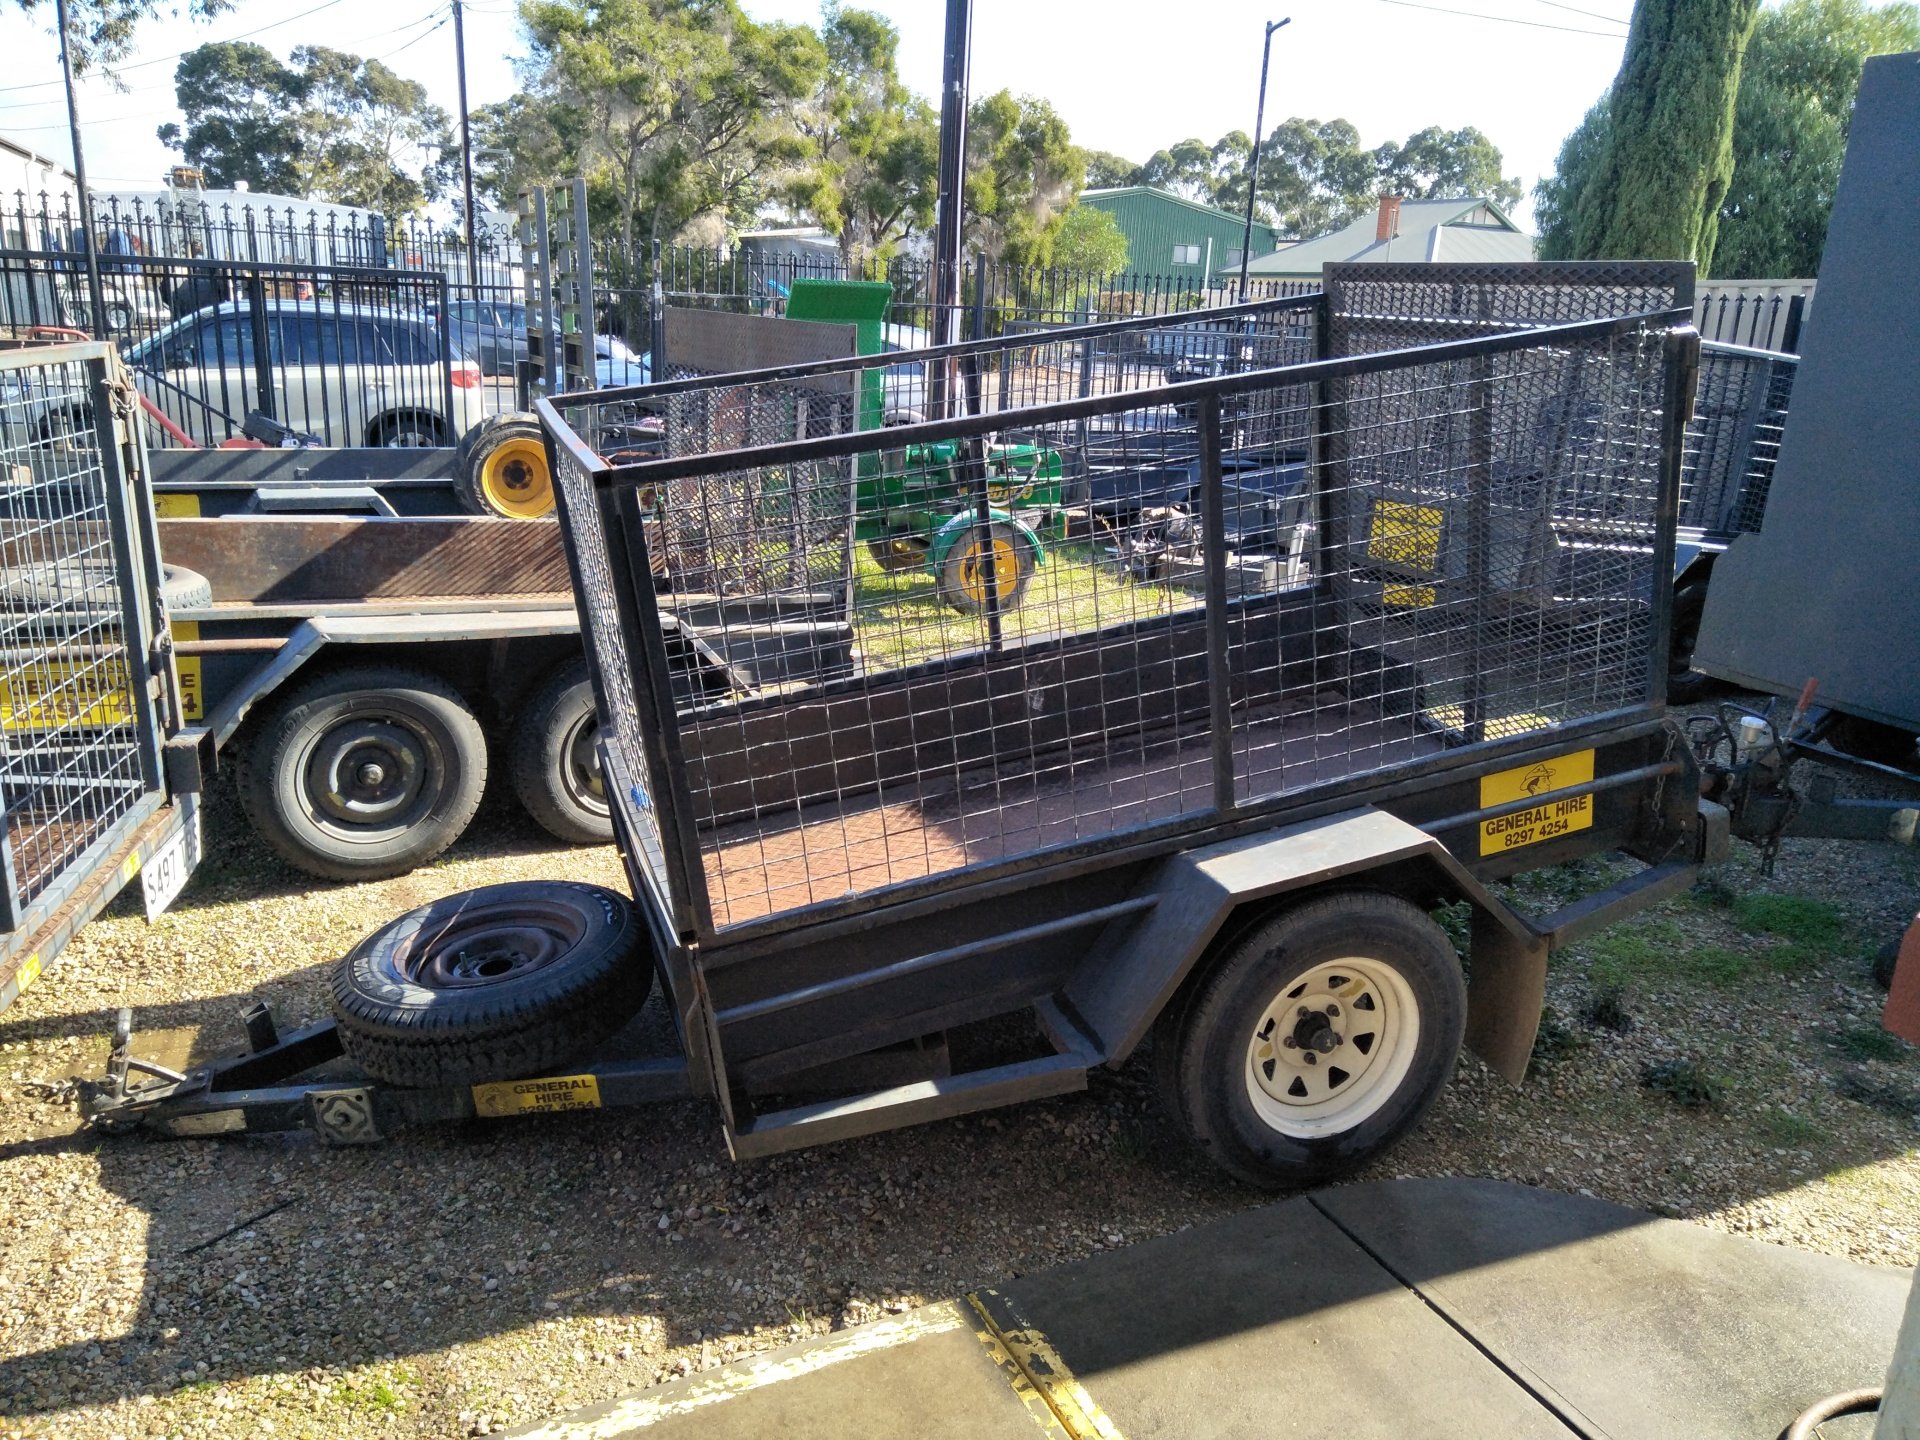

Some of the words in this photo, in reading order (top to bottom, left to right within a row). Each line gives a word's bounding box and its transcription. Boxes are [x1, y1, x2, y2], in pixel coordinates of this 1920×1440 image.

[492, 222, 509, 235] 20
[8, 676, 126, 696] GENERAL
[12, 696, 92, 722] 8297
[1486, 807, 1550, 836] GENERAL
[1556, 797, 1587, 816] HIRE
[1504, 828, 1535, 848] 8297
[1539, 818, 1569, 838] 4254
[148, 849, 176, 904] S497
[513, 1079, 592, 1094] GENERAL
[535, 1091, 575, 1104] HIRE
[559, 1100, 595, 1112] 4254
